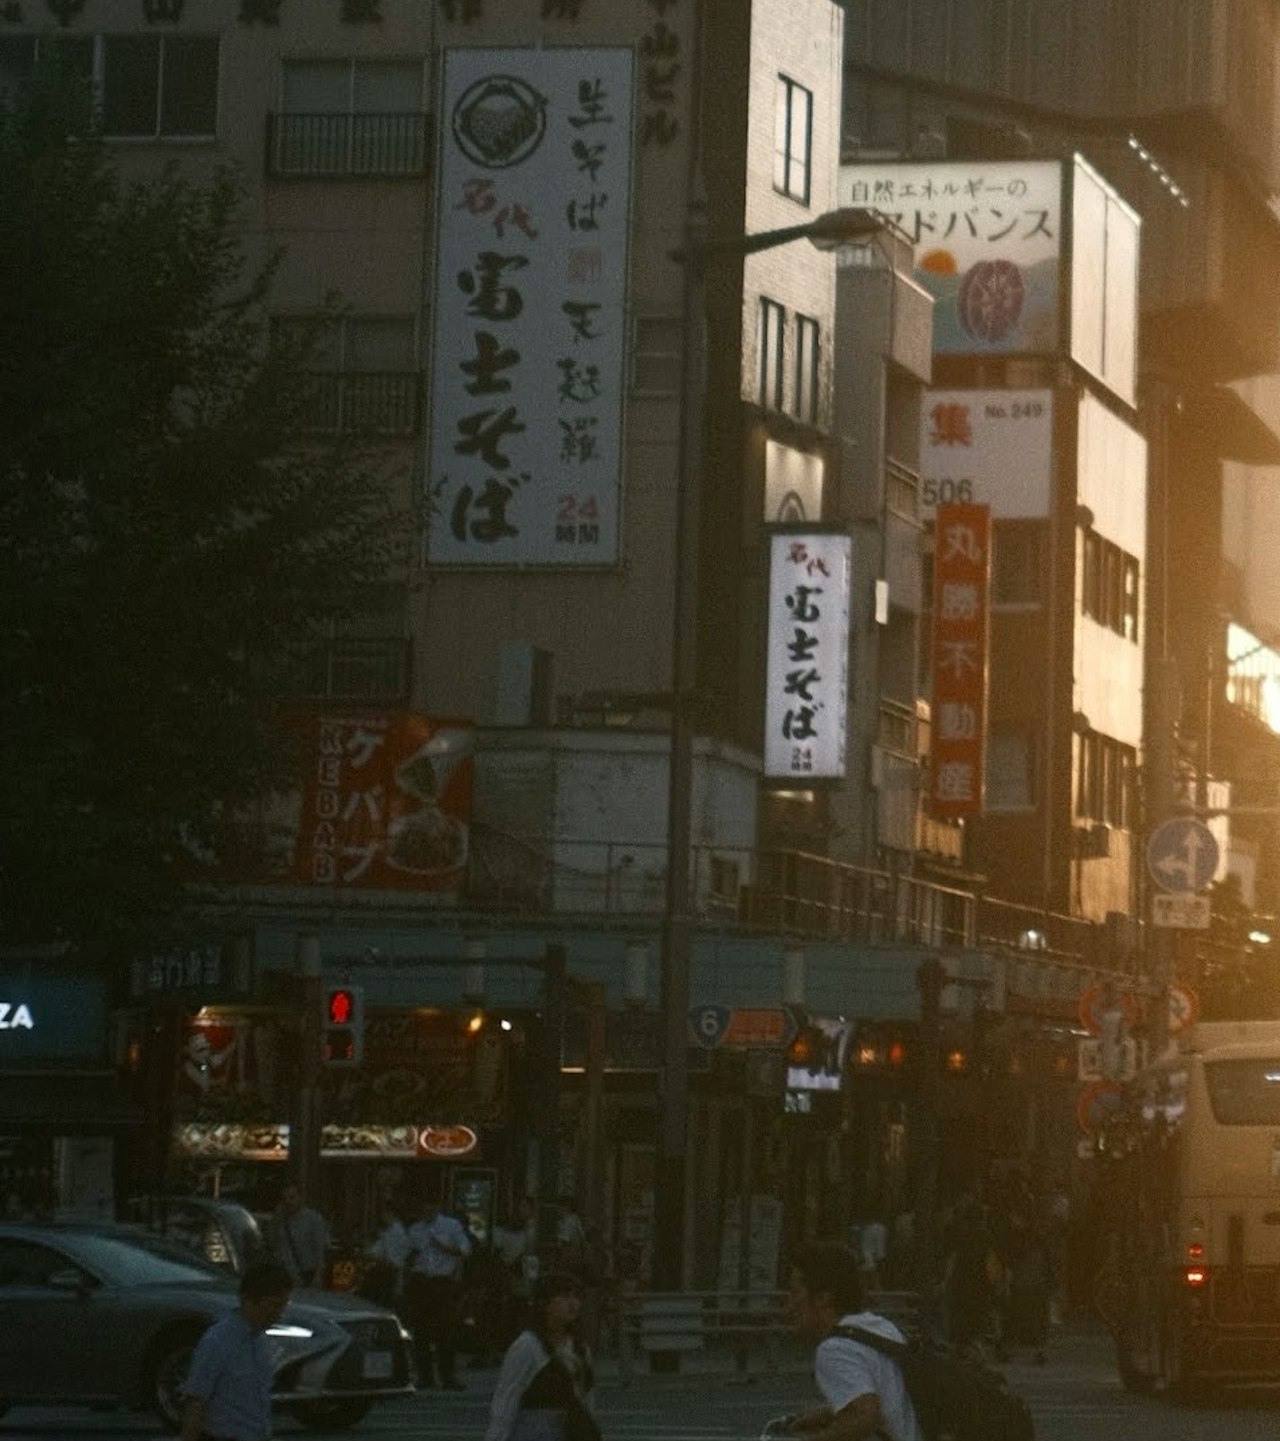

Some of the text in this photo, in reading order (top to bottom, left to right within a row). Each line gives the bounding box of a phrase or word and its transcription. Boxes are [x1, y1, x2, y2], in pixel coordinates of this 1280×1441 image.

[567, 78, 613, 233] 生そば
[852, 177, 1028, 203] 自然エネルギーの
[451, 250, 532, 543] 富士そば
[557, 493, 599, 520] 24
[923, 478, 973, 506] 506
[782, 585, 825, 741] 富士そば
[342, 729, 385, 882] ケバブ
[701, 1009, 719, 1036] 6
